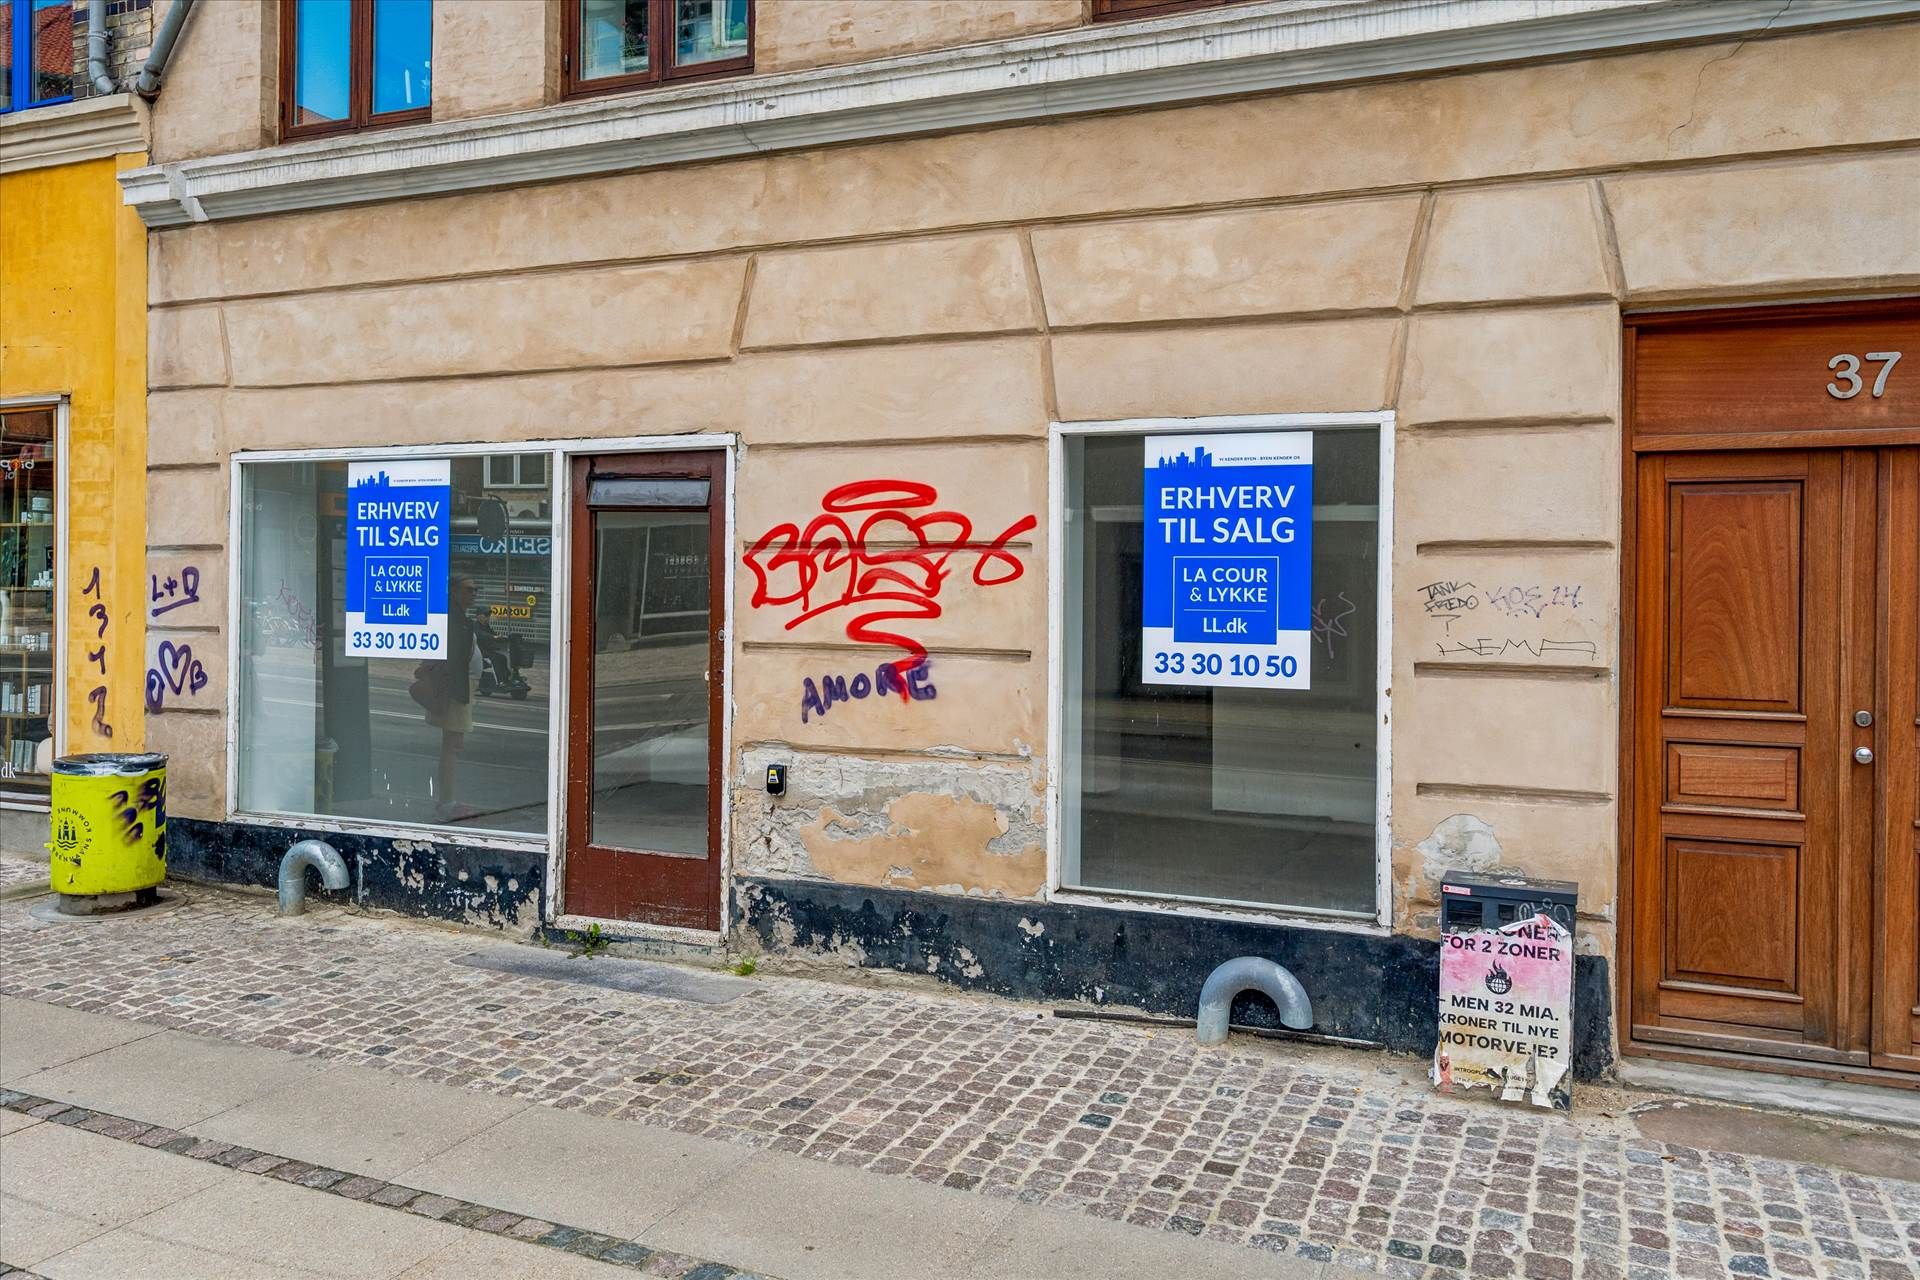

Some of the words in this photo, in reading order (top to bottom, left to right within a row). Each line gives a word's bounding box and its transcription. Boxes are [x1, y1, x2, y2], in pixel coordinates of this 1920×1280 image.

[1826, 351, 1903, 399] 37
[1161, 485, 1296, 509] ERHVERV
[357, 501, 440, 520] ERHVERV
[356, 526, 385, 547] TIL
[389, 525, 439, 547] SALG
[1158, 518, 1205, 543] TIL
[1212, 516, 1295, 543] SALG
[371, 565, 386, 577] LA
[388, 565, 423, 578] COUR
[1183, 568, 1207, 583] LA
[1212, 567, 1268, 583] COUR
[374, 580, 383, 592] &
[386, 580, 423, 593] LYKKE
[1190, 587, 1202, 602] &
[1208, 587, 1268, 603] LYKKE
[382, 604, 410, 617] LL.dk
[1203, 617, 1248, 634] LL.dk
[353, 631, 372, 648] 33
[375, 632, 395, 649] 30
[398, 632, 417, 650] 10
[419, 633, 440, 651] 50
[1154, 652, 1185, 674] 33
[1191, 653, 1222, 675] 30
[1230, 654, 1260, 677] 10
[1265, 655, 1298, 678] 50
[801, 660, 937, 724] AMORE
[1481, 939, 1492, 953] 2
[1498, 941, 1561, 962] ZONER
[1451, 995, 1489, 1011] MEN
[1494, 1001, 1514, 1015] 32
[1519, 1004, 1559, 1021] MIA.
[1439, 1012, 1498, 1030] KRONER
[1502, 1021, 1524, 1034] TIL
[1527, 1025, 1559, 1040] NYE
